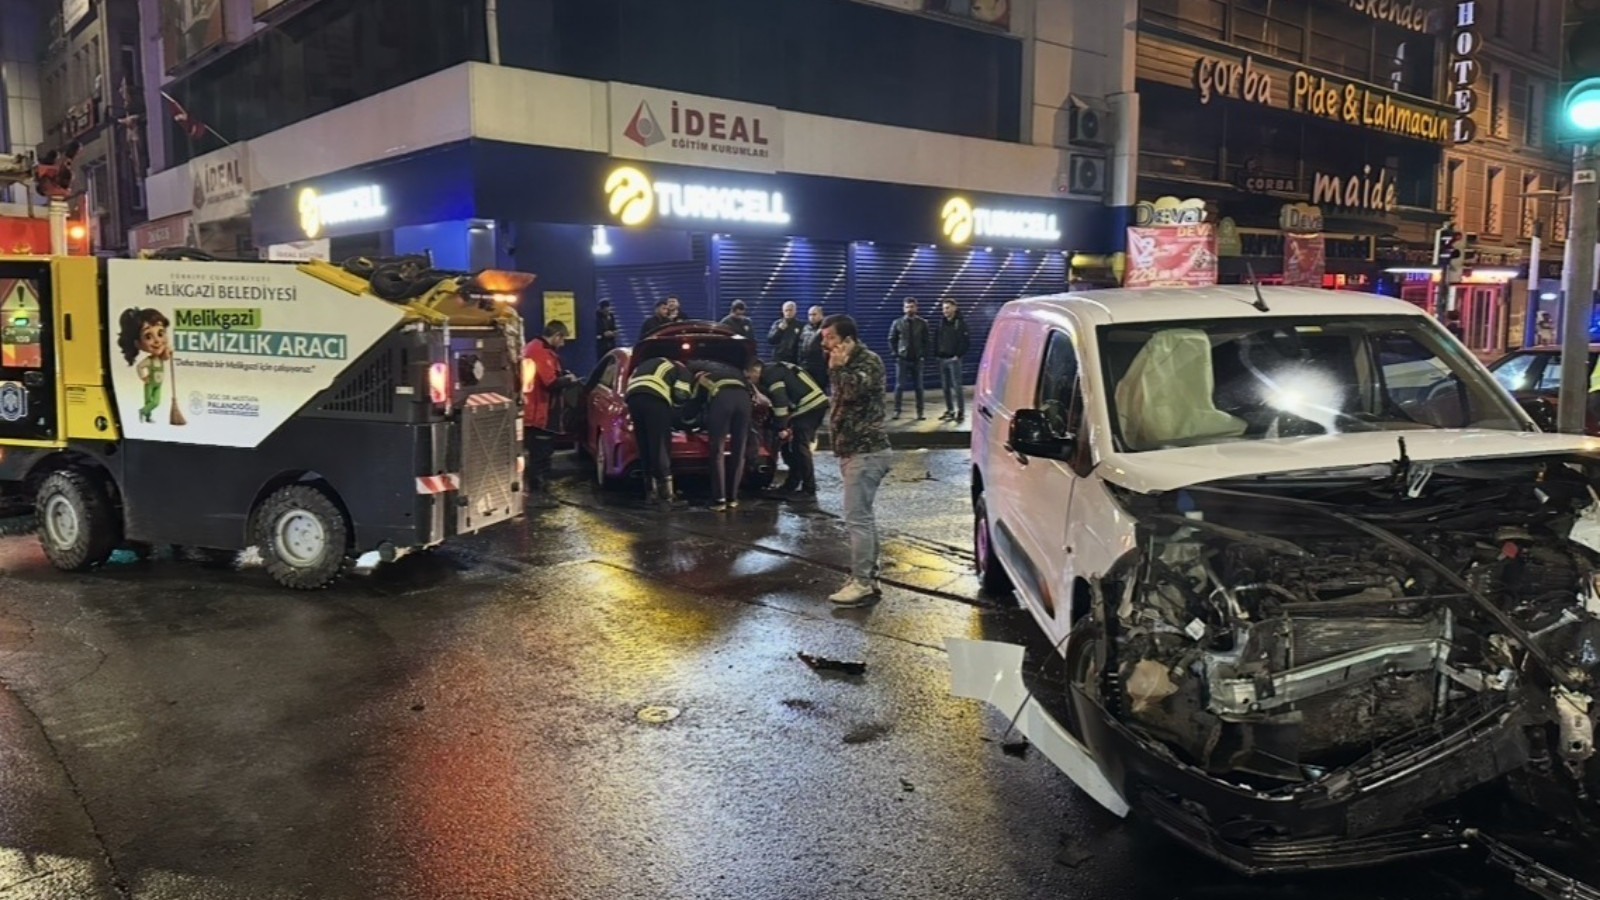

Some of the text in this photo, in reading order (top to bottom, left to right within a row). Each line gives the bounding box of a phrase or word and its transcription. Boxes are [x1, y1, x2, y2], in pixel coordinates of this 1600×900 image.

[1198, 56, 1271, 103] çorba
[1454, 1, 1475, 142] HOTEL
[671, 100, 769, 145] İDEAL
[1295, 71, 1448, 139] Pide & Lahmacun
[671, 138, 769, 158] EĞİTİM KURUMLARI
[314, 185, 387, 225] TCELL
[653, 182, 792, 223] TURKCELL
[972, 208, 1061, 240] TURKCELL
[145, 281, 298, 301] MELİKGAZİ BELEDİYESİ
[175, 309, 254, 330] Melikgazi
[277, 335, 344, 358] ARACI
